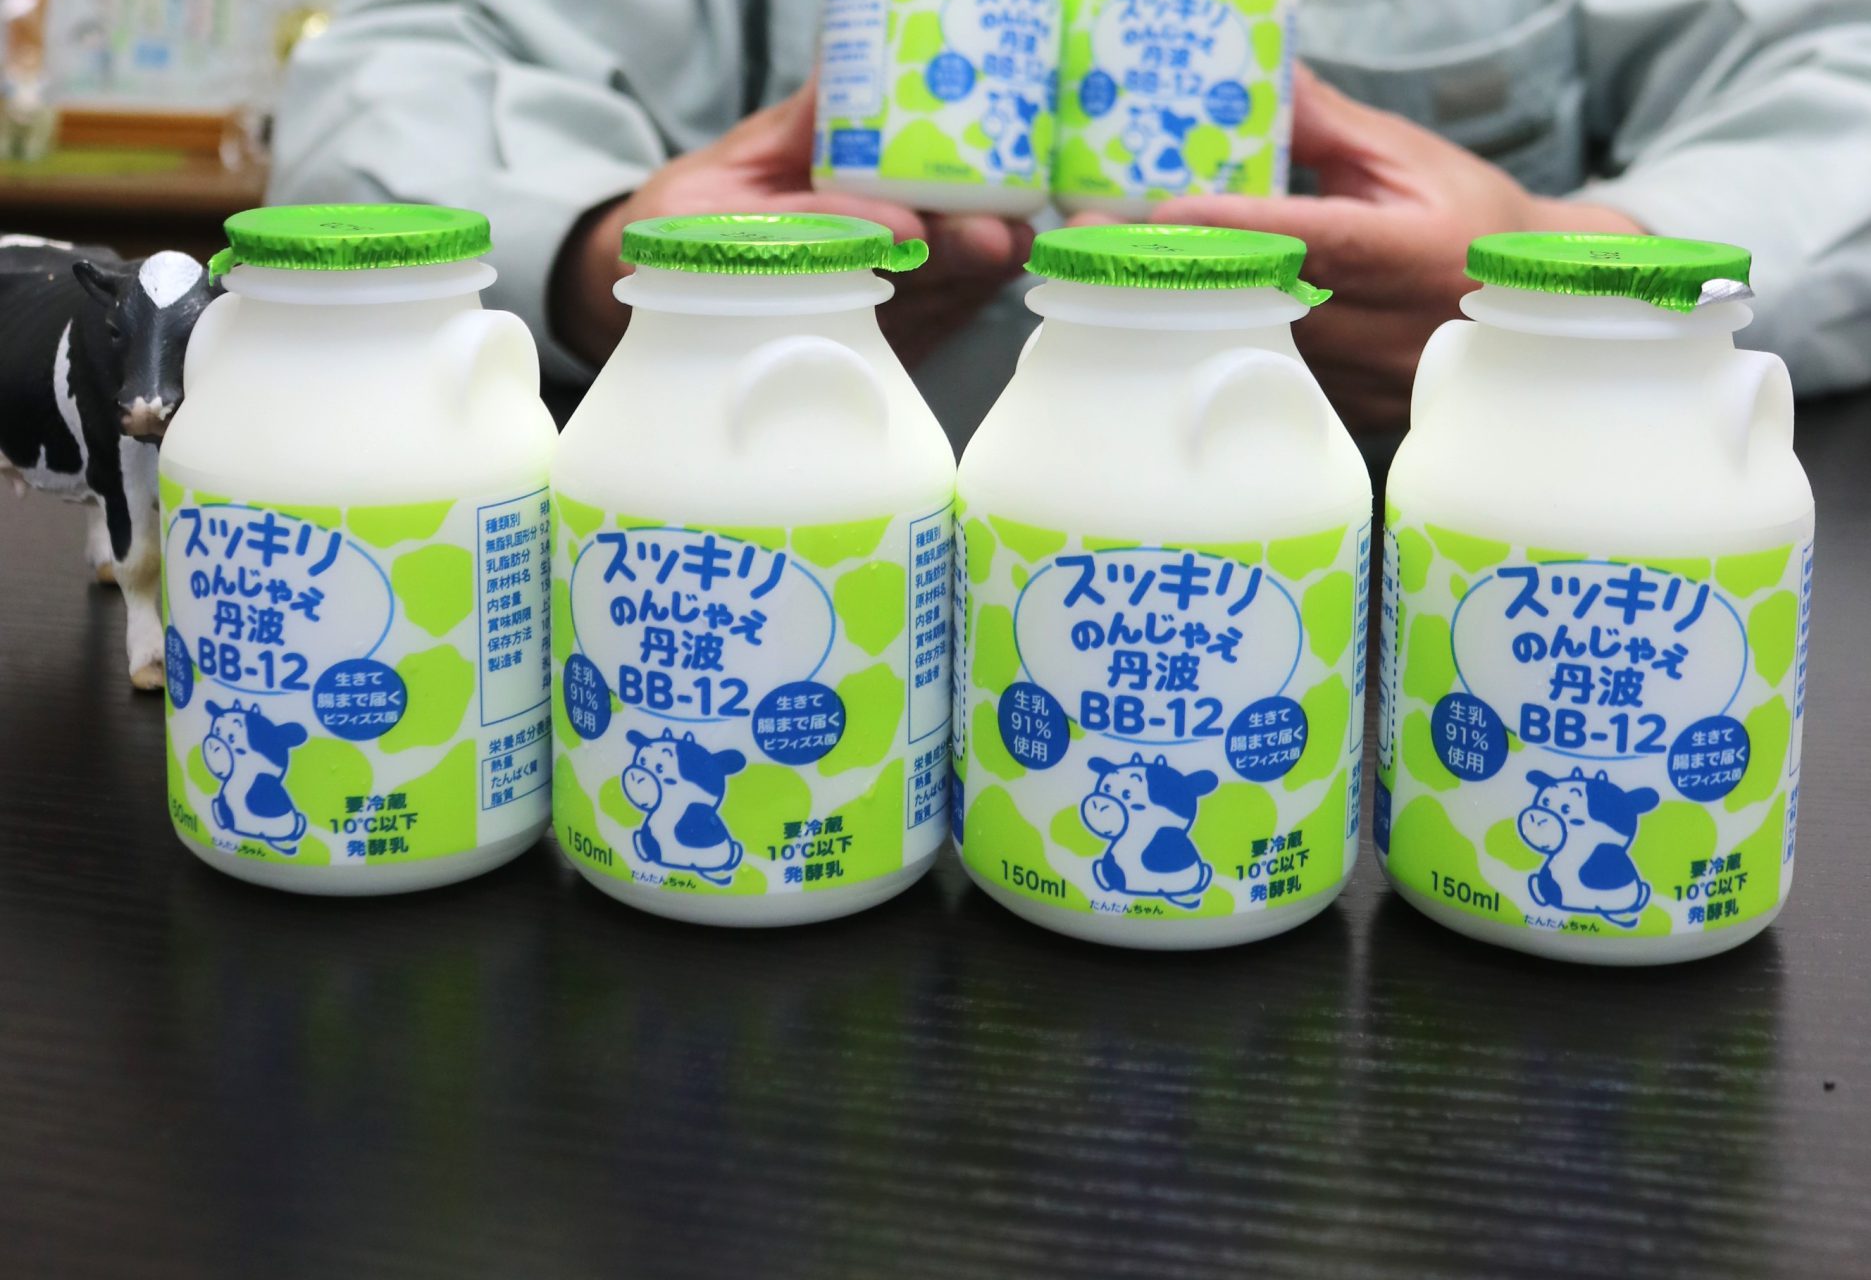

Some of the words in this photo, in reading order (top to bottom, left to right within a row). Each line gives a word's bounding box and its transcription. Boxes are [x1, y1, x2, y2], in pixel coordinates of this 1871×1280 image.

[485, 512, 521, 533] 種類別
[486, 549, 530, 574] 乳脂肪分
[191, 566, 325, 622] のんじゃえ
[486, 568, 532, 594] 原材料名
[487, 592, 522, 613] 内容量
[214, 601, 285, 646] 丹波
[488, 607, 532, 634] 賞味期限
[610, 589, 767, 645] のんじゃえ
[488, 627, 533, 653] 保存方法
[640, 627, 724, 672] 丹波
[1072, 612, 1243, 663] のんじゃえ
[198, 638, 310, 691] BB-12
[1513, 625, 1689, 680] のんじゃえ
[335, 671, 383, 687] 生きて
[571, 661, 596, 688] 生乳
[1109, 650, 1200, 692] 丹波
[619, 665, 751, 718] BB-12
[1549, 664, 1645, 707] 丹波
[317, 690, 400, 709] 腸まで届く
[571, 687, 598, 711] 91%
[776, 694, 823, 711] 生きて
[1014, 691, 1049, 716] 生乳
[573, 708, 596, 733] 使用
[757, 712, 841, 733] 腸まで届く
[1011, 714, 1051, 739] 91%
[1080, 691, 1225, 737] BB-12
[1249, 708, 1291, 727] 生きて
[1449, 700, 1487, 727] 生乳
[1231, 725, 1304, 753] 腸まで届く
[1446, 724, 1488, 752] 91%
[1519, 703, 1667, 754] BB-12
[1691, 728, 1734, 747] 生きて
[763, 733, 837, 751] ビフィズス菌
[1013, 737, 1048, 762] 使用
[1235, 747, 1301, 769] ビフィズス菌
[1447, 747, 1485, 774] 使用
[1673, 745, 1747, 771] 腸まで届く
[345, 793, 407, 814] 要冷蔵
[784, 817, 843, 838] 要冷蔵
[347, 836, 409, 857] 発酵乳
[567, 826, 613, 867] 150ml
[1250, 830, 1303, 856] 要冷蔵
[784, 856, 843, 884] 発酵乳
[1001, 859, 1066, 899] 150ml
[1690, 853, 1741, 879] 要冷蔵
[1250, 876, 1302, 903] 発酵乳
[1430, 871, 1500, 911] 150ml
[1687, 898, 1739, 925] 発酵乳
